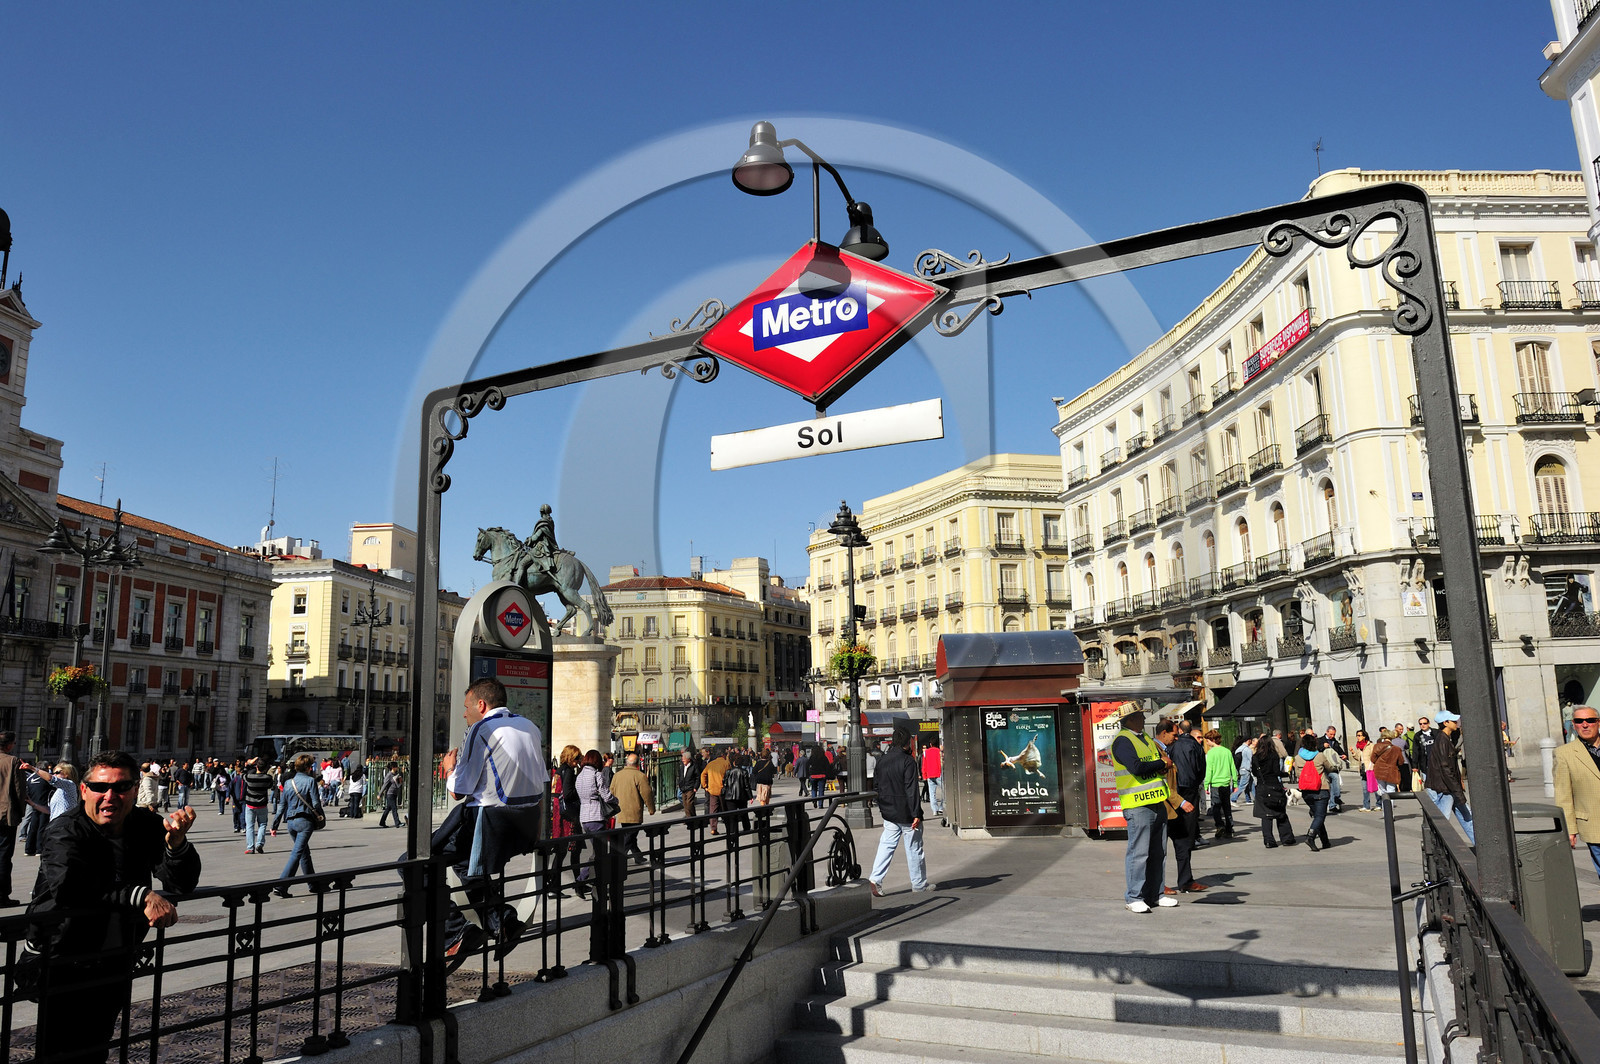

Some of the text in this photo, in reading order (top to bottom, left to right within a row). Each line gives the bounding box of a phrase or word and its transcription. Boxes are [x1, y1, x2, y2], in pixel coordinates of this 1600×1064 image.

[762, 297, 859, 338] Metro
[797, 421, 843, 449] Sol
[505, 614, 523, 625] Metro
[1001, 781, 1049, 797] nebbia
[1134, 789, 1165, 802] PUERTA
